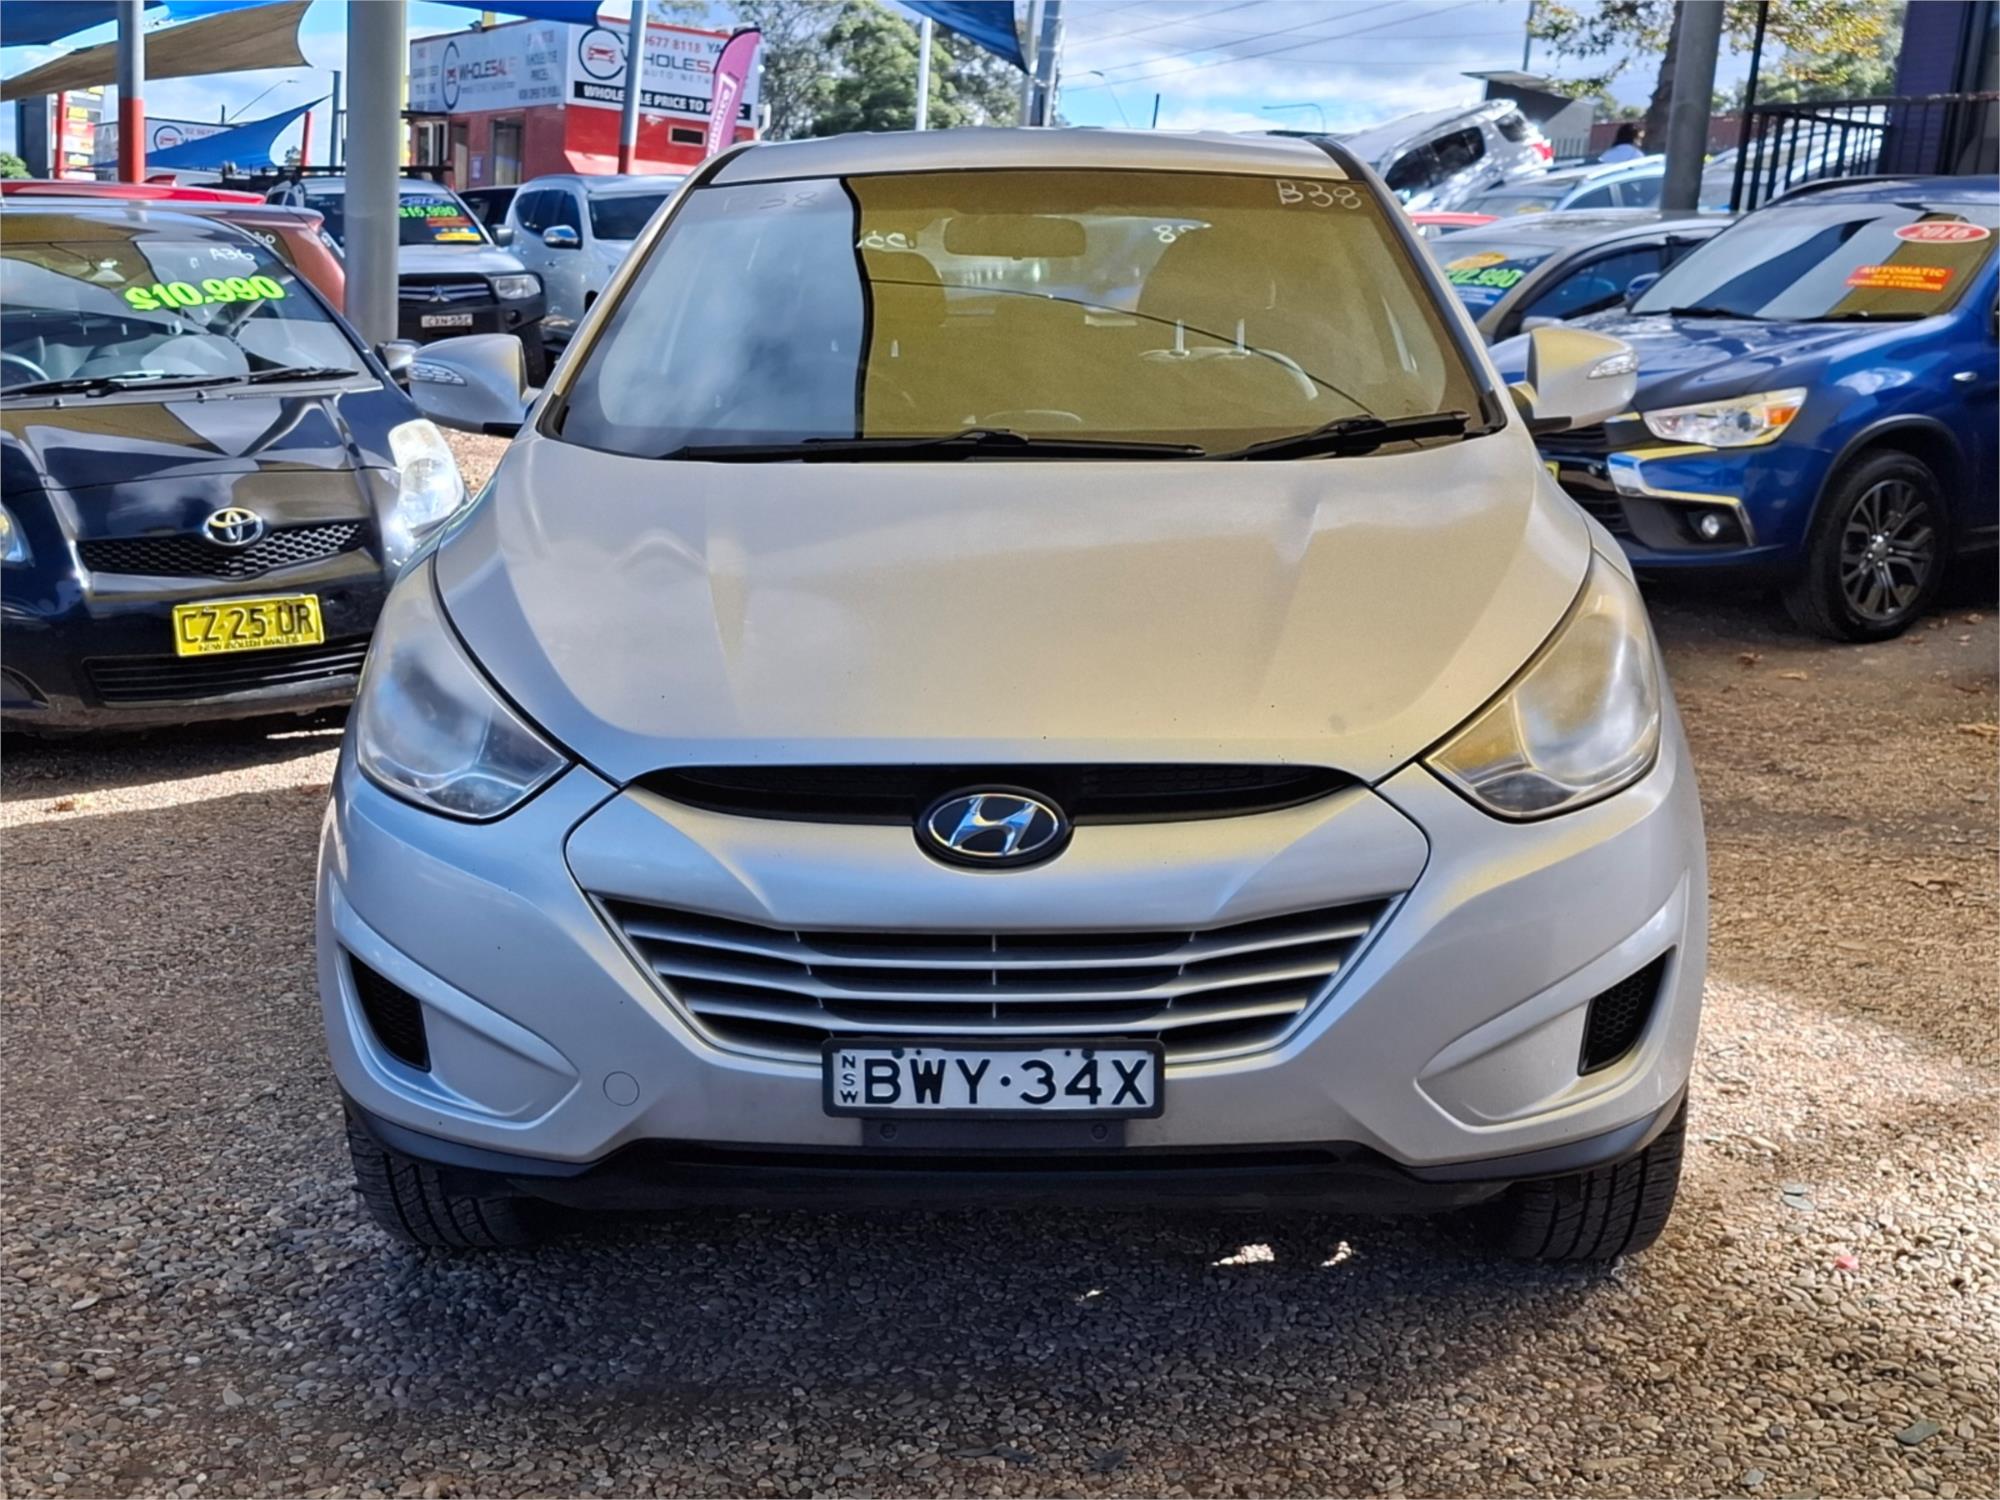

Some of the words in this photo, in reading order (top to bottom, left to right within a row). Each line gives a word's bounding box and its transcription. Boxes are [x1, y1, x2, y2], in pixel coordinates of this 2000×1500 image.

[654, 94, 687, 111] PRICE
[689, 99, 705, 112] TO
[1276, 179, 1362, 210] B38
[1859, 265, 1946, 278] AUTOMATIC
[840, 1054, 859, 1104] NSW
